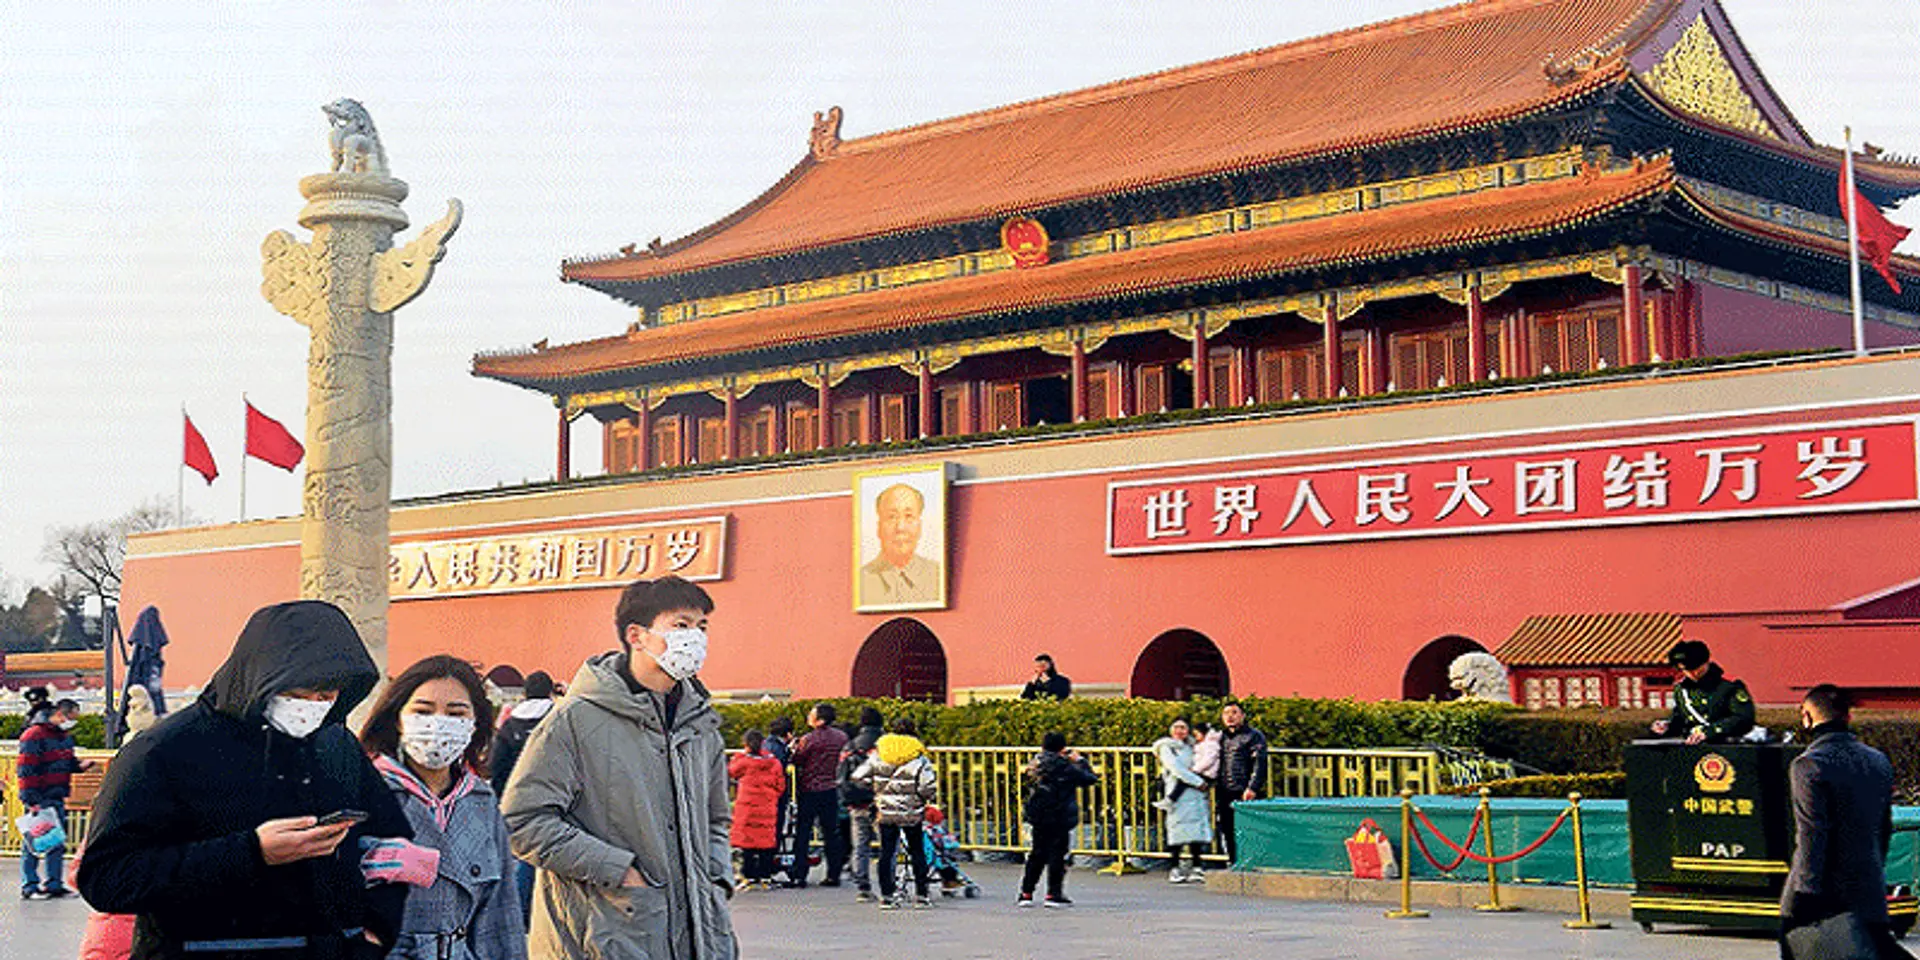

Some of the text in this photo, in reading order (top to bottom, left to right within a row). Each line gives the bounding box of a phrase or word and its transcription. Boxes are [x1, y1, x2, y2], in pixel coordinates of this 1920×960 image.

[1141, 438, 1870, 540] 世界人民大团结万岁
[1701, 842, 1745, 858] PAP
